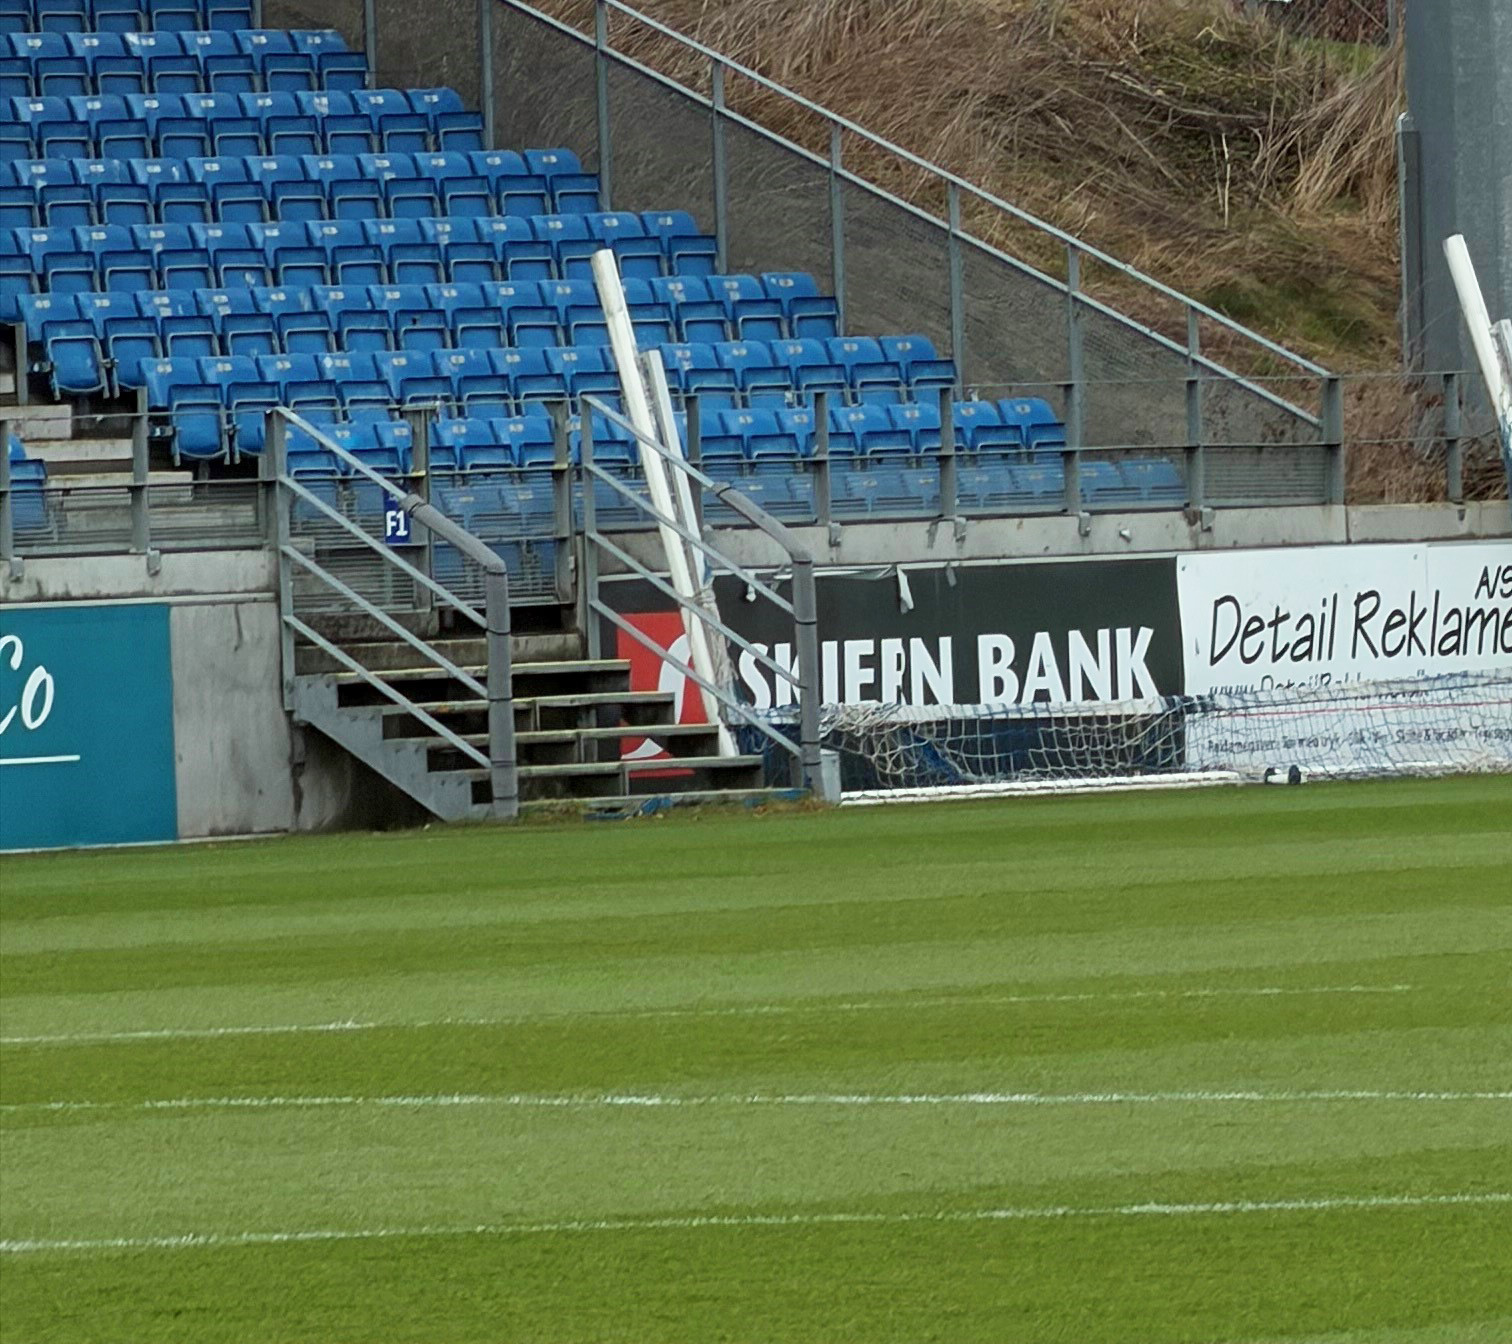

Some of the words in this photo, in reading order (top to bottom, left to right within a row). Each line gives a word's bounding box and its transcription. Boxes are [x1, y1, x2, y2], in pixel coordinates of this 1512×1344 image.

[386, 510, 408, 537] F1
[978, 627, 1160, 704] BANK
[1209, 593, 1338, 666] Detail
